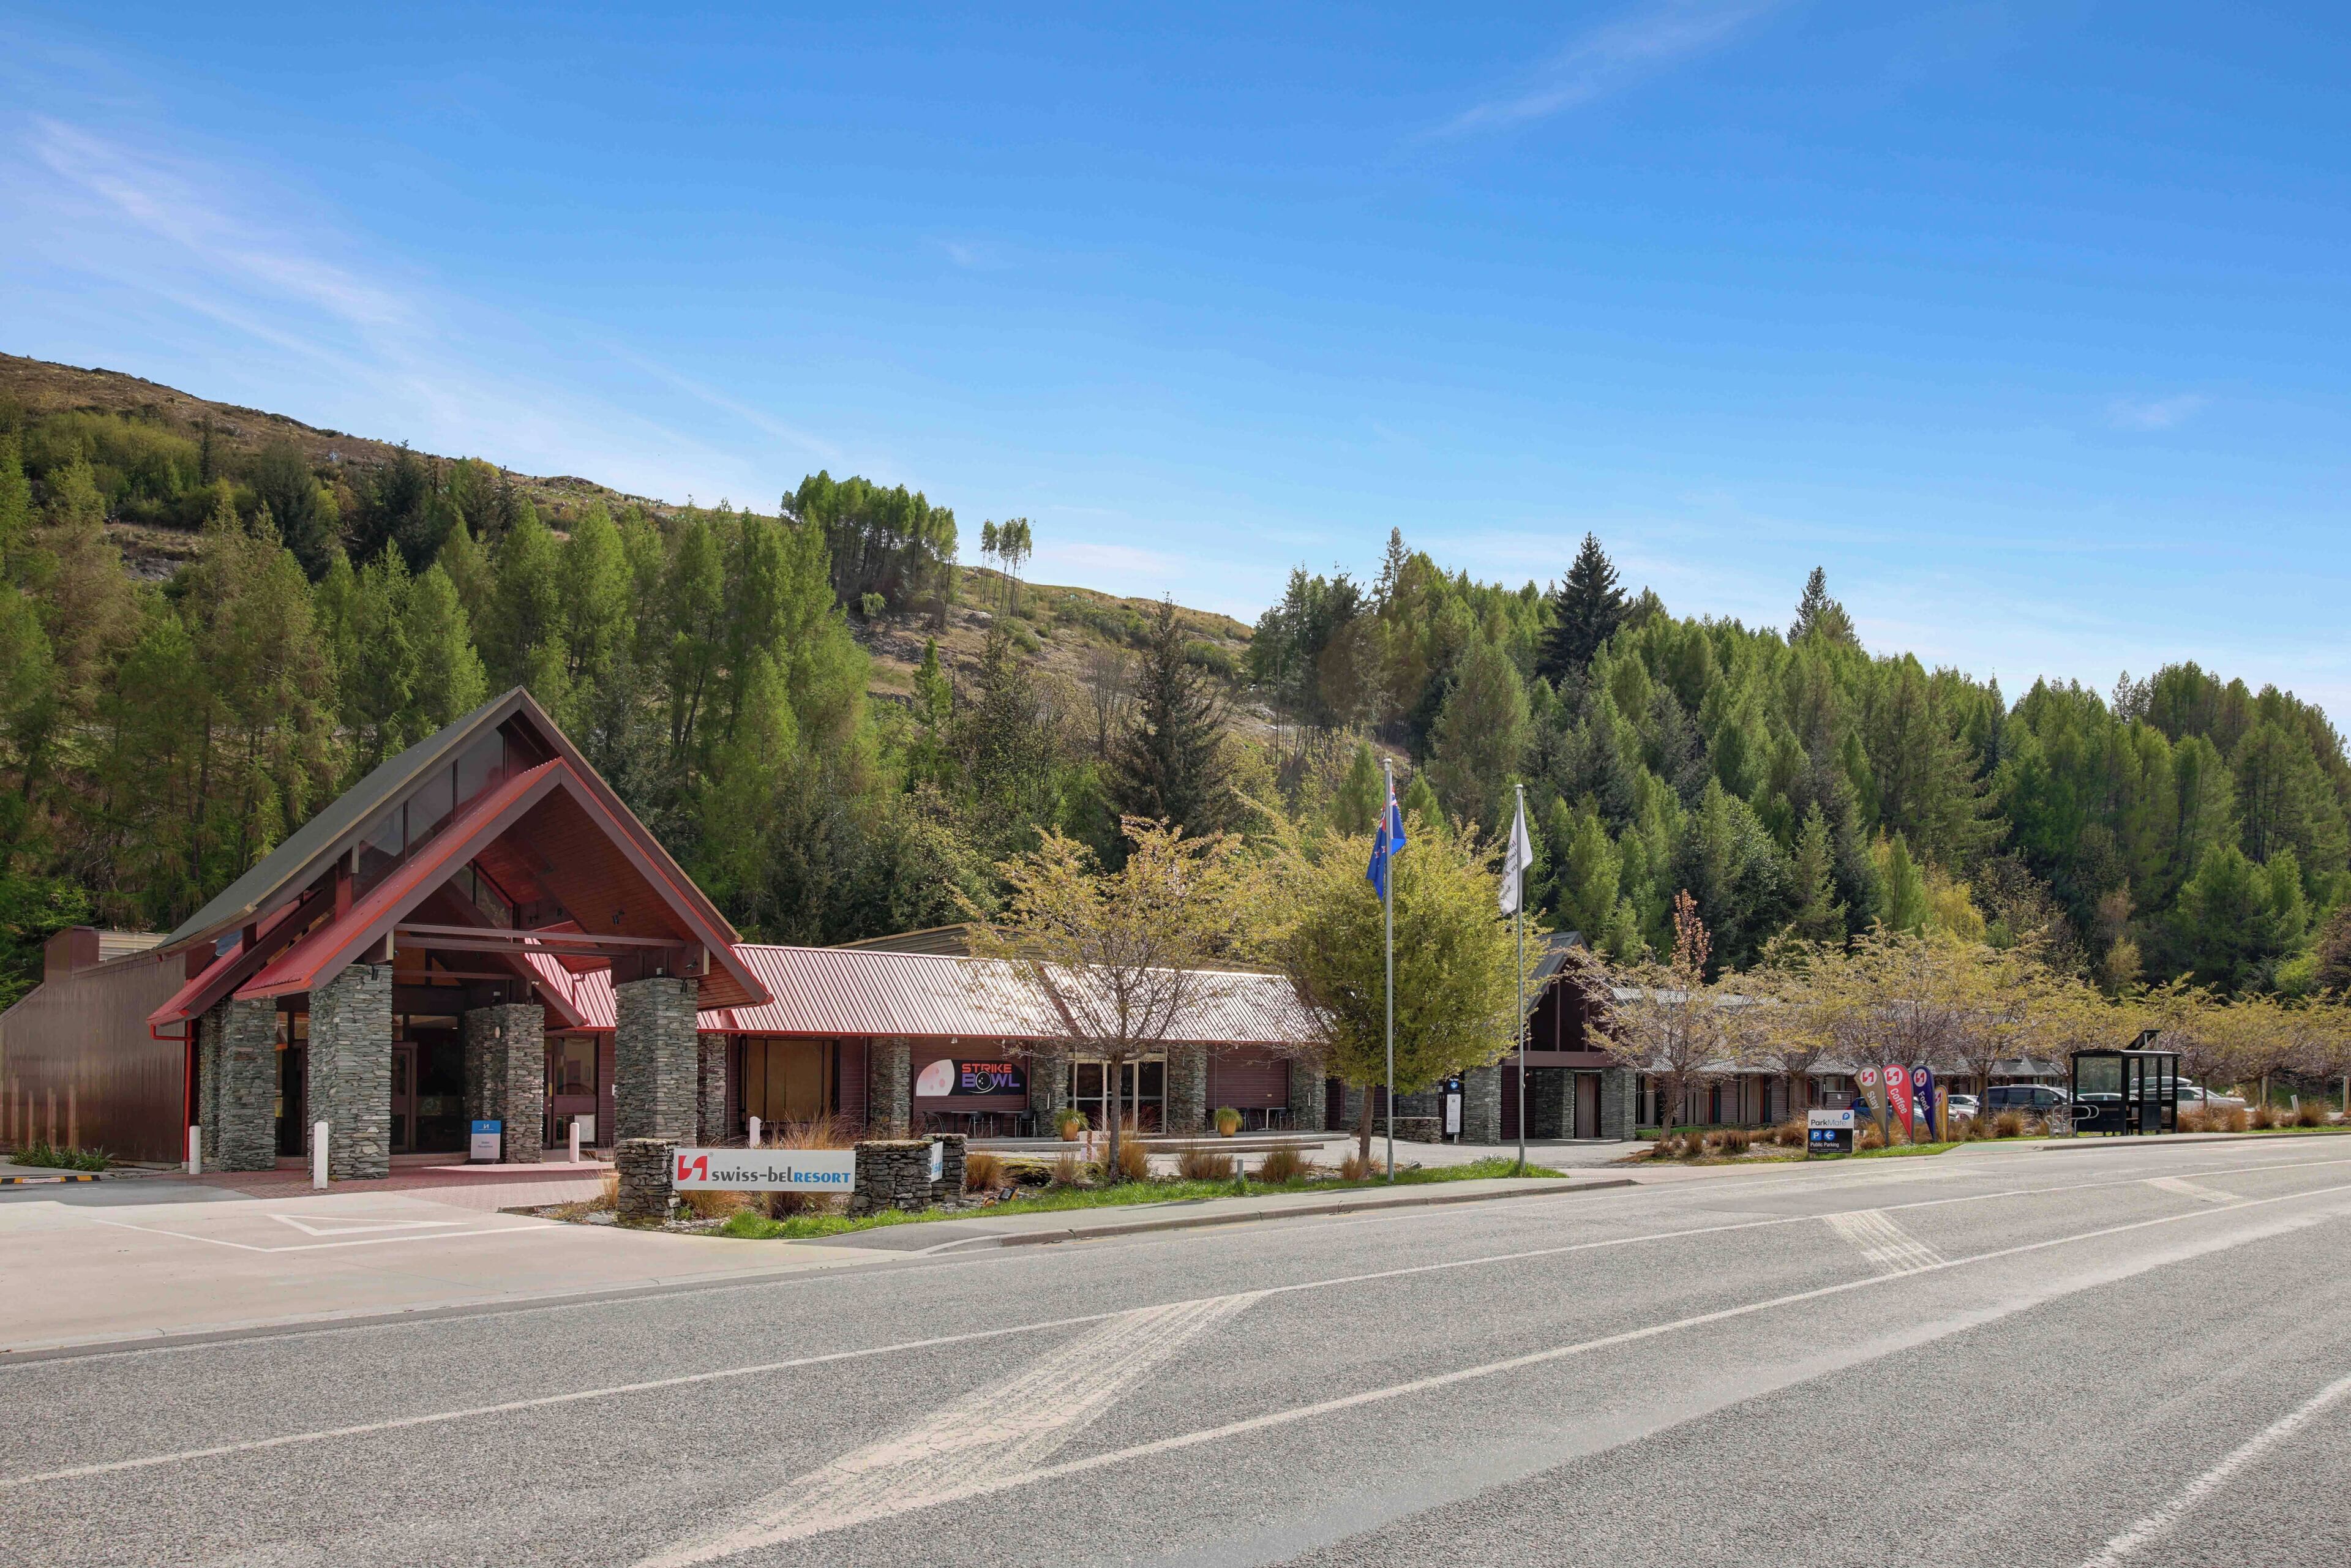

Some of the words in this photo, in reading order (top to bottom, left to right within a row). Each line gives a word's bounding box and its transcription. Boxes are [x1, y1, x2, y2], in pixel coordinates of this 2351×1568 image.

[961, 1063, 1012, 1073] STRIKE
[962, 1071, 1021, 1090] BOWL
[1867, 1090, 1880, 1110] Stay
[1890, 1088, 1908, 1114] Coffee
[1918, 1090, 1930, 1111] Food
